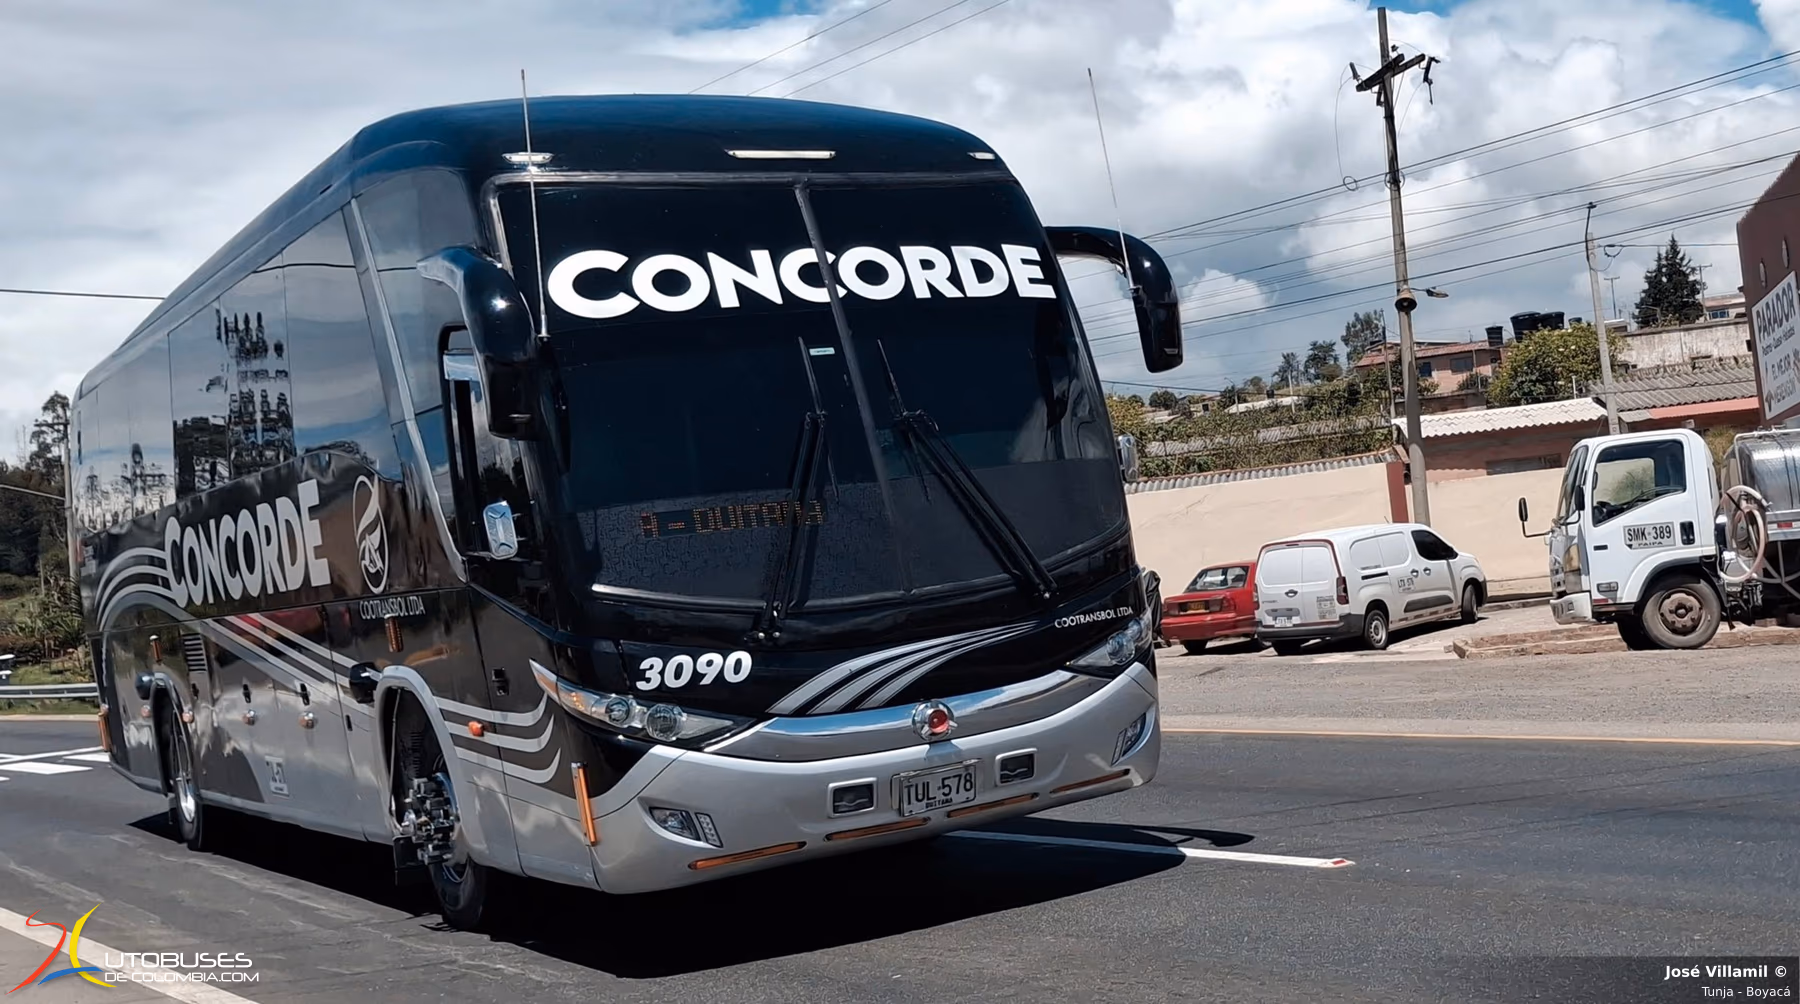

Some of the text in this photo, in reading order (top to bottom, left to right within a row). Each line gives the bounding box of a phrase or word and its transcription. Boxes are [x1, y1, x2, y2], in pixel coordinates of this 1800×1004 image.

[547, 244, 1057, 318] CONCORDE
[1756, 282, 1796, 343] PARADOR
[165, 478, 331, 608] CONCORDE
[360, 595, 426, 619] COOTRANSBOL LTDA
[1054, 606, 1134, 628] COOTRANSBOL LTDA
[636, 650, 752, 691] 3090
